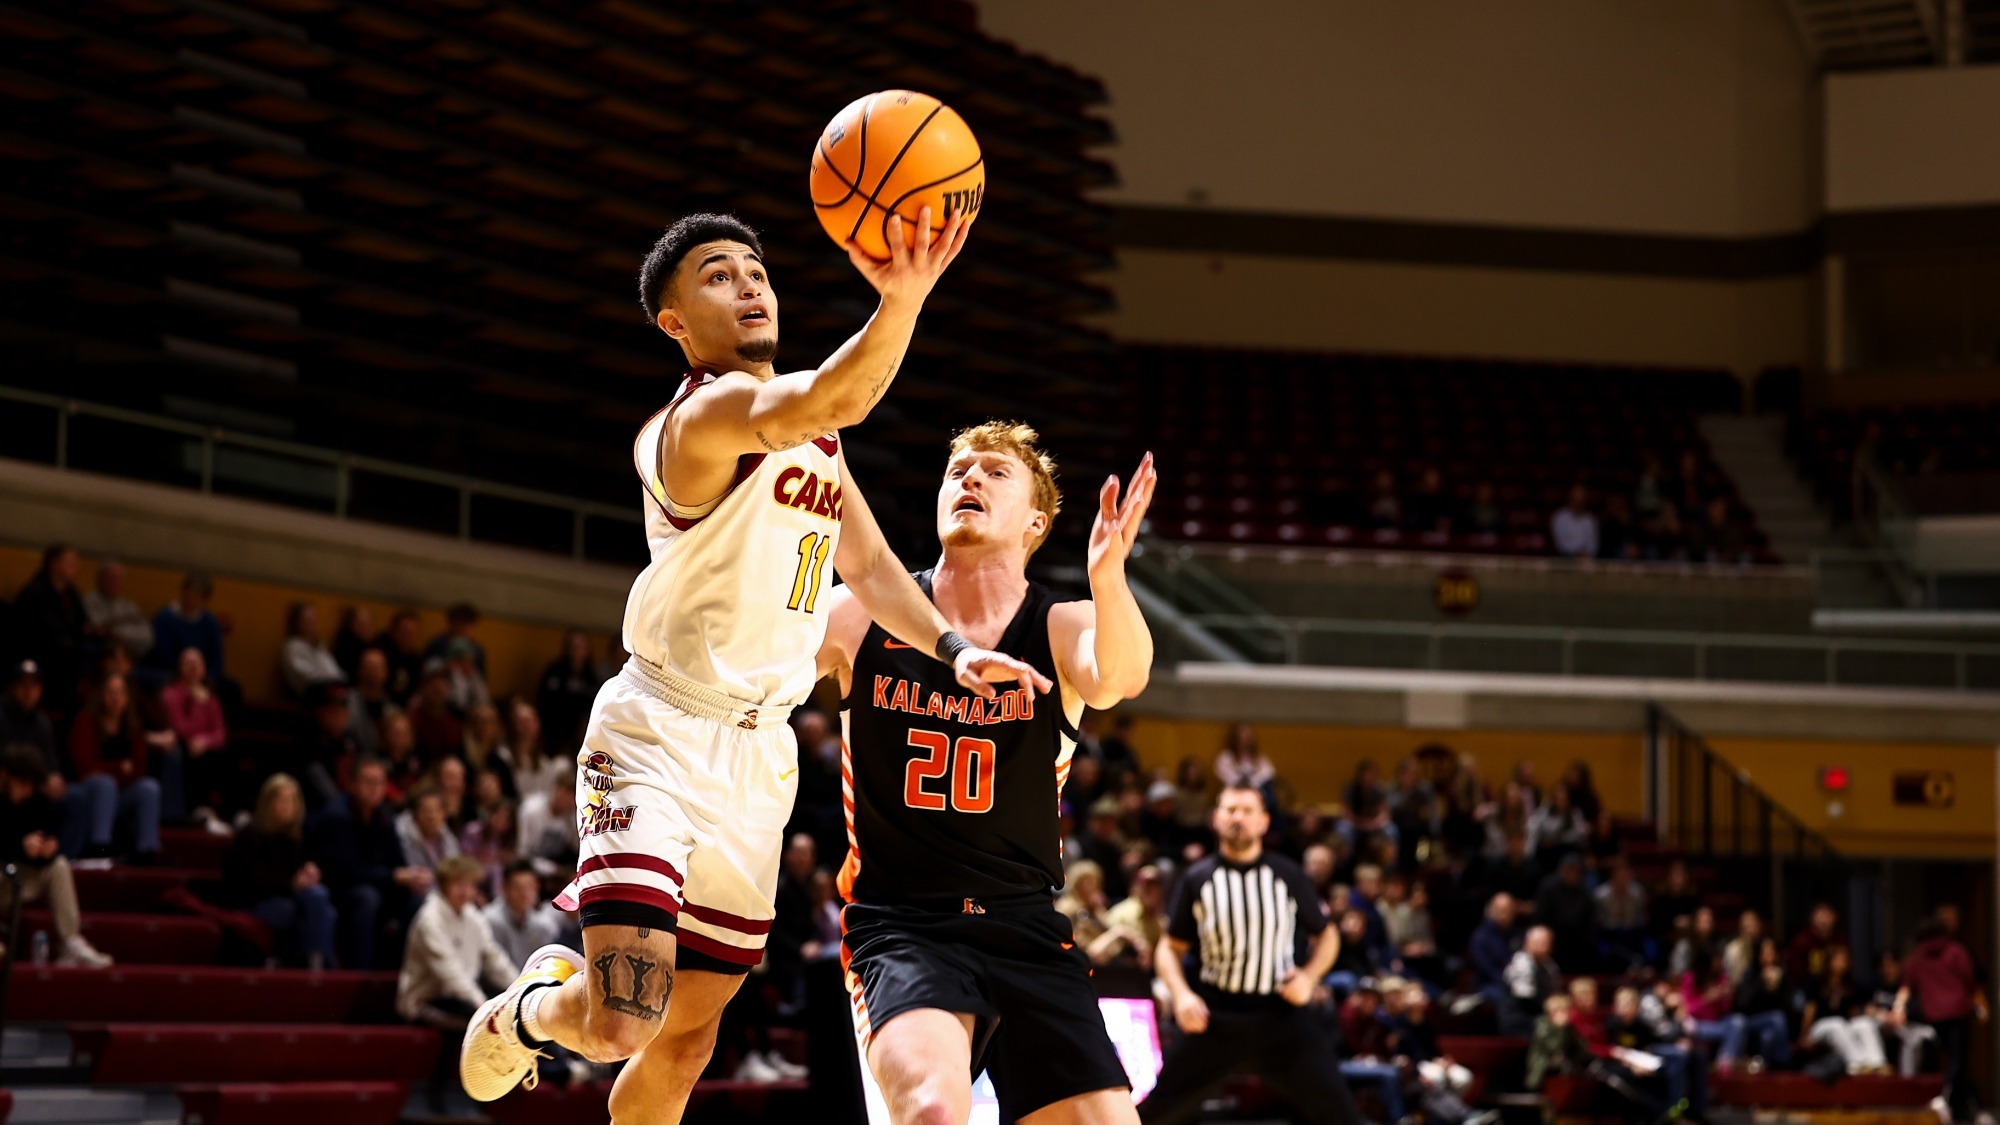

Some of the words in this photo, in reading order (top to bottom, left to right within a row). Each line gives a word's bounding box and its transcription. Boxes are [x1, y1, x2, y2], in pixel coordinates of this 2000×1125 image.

[942, 182, 983, 221] Wil
[786, 532, 830, 614] 11
[873, 674, 1035, 726] KALAMAZOO
[903, 727, 997, 814] 20
